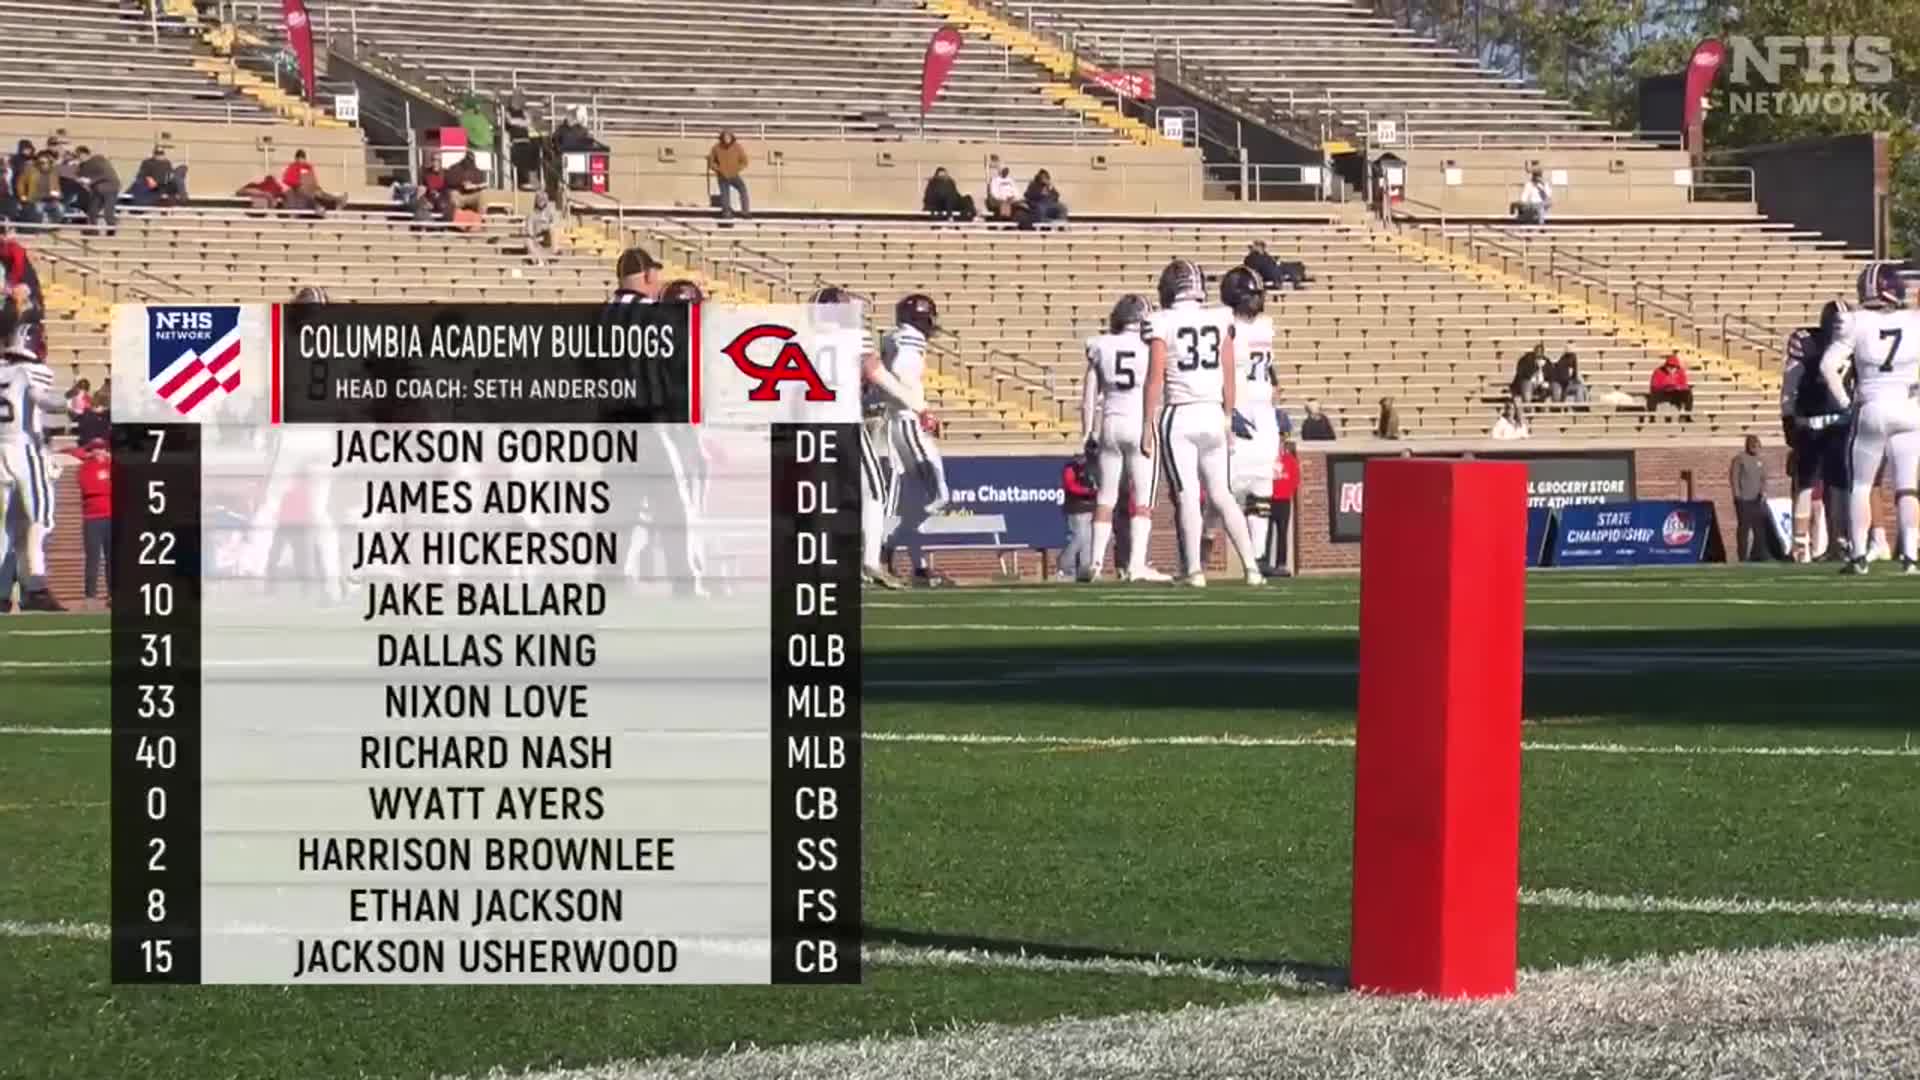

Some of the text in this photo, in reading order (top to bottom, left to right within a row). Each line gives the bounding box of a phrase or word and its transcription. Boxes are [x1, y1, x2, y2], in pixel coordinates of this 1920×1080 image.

[1177, 325, 1220, 371] 33
[1879, 328, 1903, 372] 7
[1115, 351, 1136, 390] 5
[952, 489, 976, 502] are
[1538, 481, 1588, 494] GROCERY
[1590, 480, 1624, 493] STORE
[1597, 512, 1632, 526] STATE
